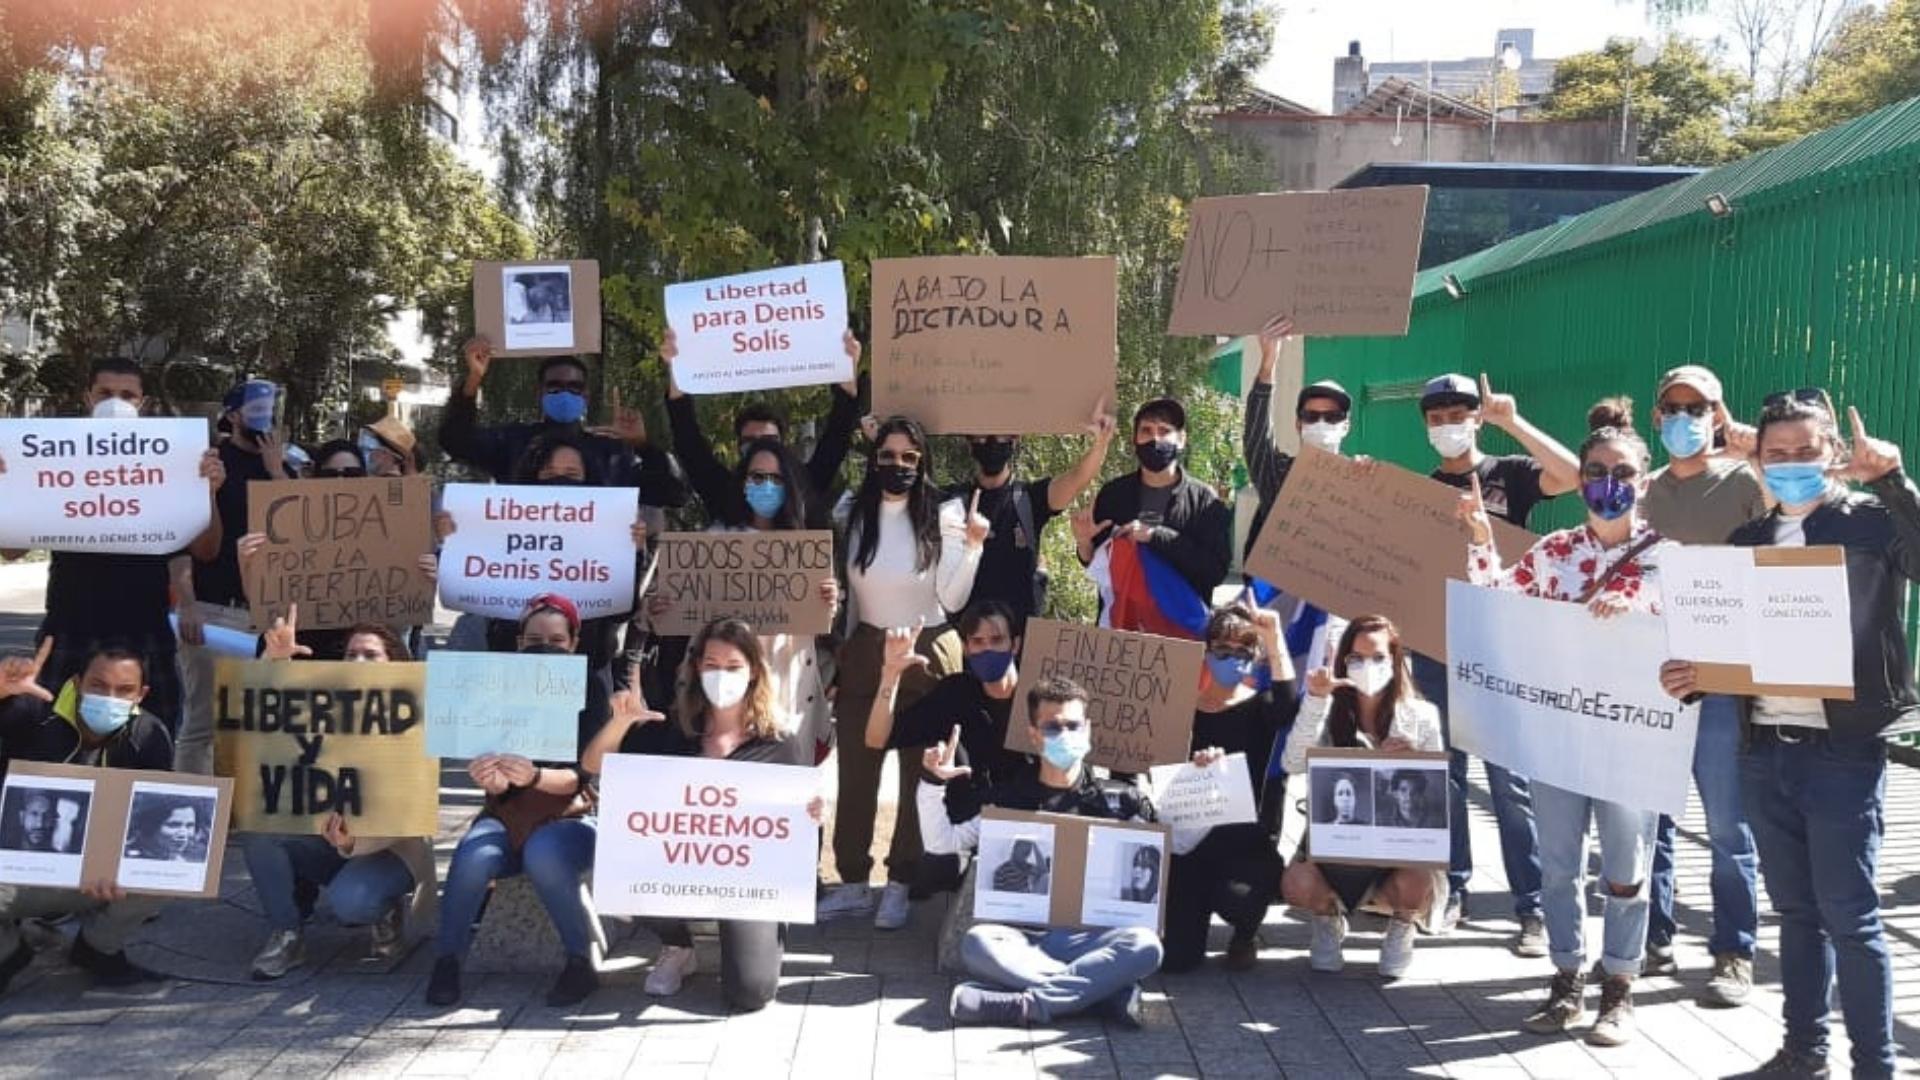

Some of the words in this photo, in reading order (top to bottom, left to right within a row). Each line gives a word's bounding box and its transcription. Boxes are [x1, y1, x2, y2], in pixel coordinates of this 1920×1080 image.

[706, 277, 807, 301] Libertad
[892, 275, 987, 307] ABAJO
[1001, 276, 1038, 303] LA
[693, 306, 746, 332] para
[755, 301, 824, 325] Denis
[892, 306, 1071, 339] DICTADURA
[733, 328, 790, 353] Solís
[22, 433, 76, 457] San
[86, 432, 170, 456] Isidro
[37, 469, 75, 488] no
[85, 464, 164, 487] están
[64, 495, 141, 518] solos
[266, 494, 389, 544] CUBA
[485, 498, 594, 524] Libertad
[87, 535, 97, 544] A
[100, 533, 138, 543] DENIS
[507, 533, 563, 554] para
[268, 549, 317, 571] POR
[334, 547, 369, 569] LA
[659, 540, 743, 569] TODOS
[752, 540, 831, 569] SOMOS
[464, 555, 540, 581] Denis
[548, 557, 610, 583] Solís
[260, 566, 409, 605] LIBERTAD
[666, 573, 711, 601] SAN
[724, 573, 809, 601] ISIDRO
[576, 598, 613, 609] VIVOS
[1674, 595, 1744, 609] QUEREMOS
[1761, 608, 1833, 618] CONECTADOS
[1691, 613, 1730, 626] VIVOS
[1057, 628, 1097, 660] FIN
[217, 686, 418, 735] LIBERTAD
[260, 763, 362, 817] VIDA
[684, 784, 738, 808] LOS
[627, 811, 790, 840] QUEREMOS
[663, 841, 751, 867] VIVOS
[661, 883, 737, 899] QUEREMOS
